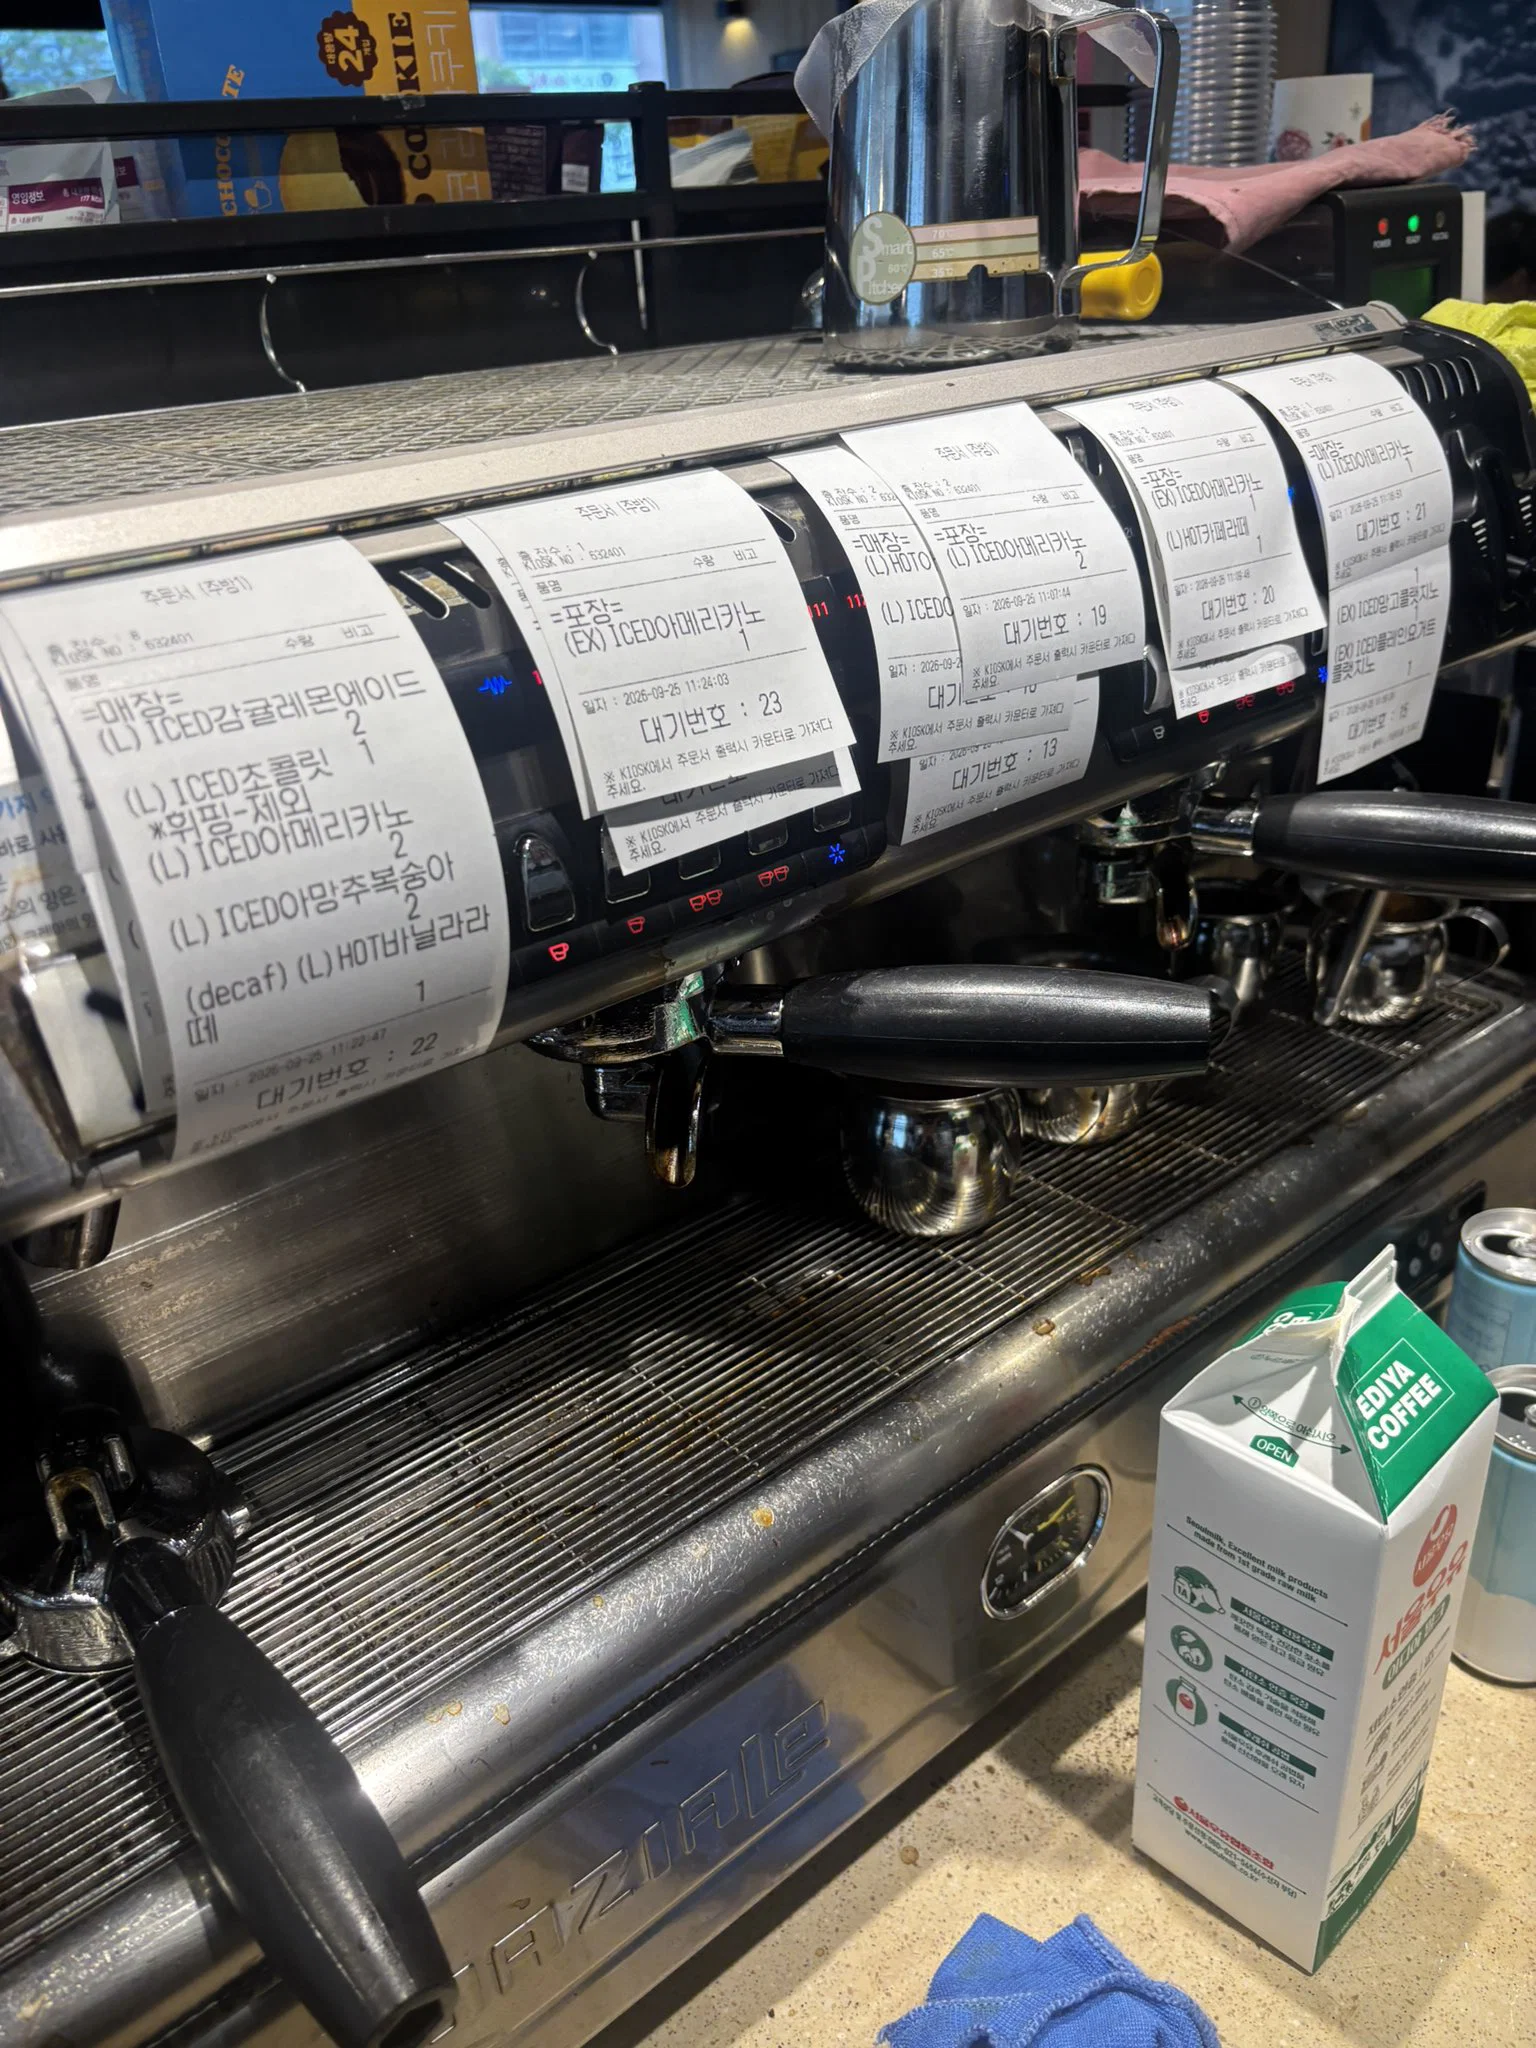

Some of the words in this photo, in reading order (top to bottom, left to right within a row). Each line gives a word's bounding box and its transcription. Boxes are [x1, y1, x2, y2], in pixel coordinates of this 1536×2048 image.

[334, 25, 366, 73] 24
[862, 217, 913, 257] Smart
[1308, 440, 1344, 461] =매장=
[1404, 457, 1413, 473] 1
[1141, 468, 1183, 489] =포장=
[575, 503, 619, 521] 주문서
[1249, 495, 1256, 512] 1
[934, 524, 987, 546] =포장=
[1356, 511, 1400, 541] 대기번호
[1415, 502, 1427, 521] 21
[522, 556, 556, 572] KIOSK
[561, 553, 575, 566] NO
[589, 546, 626, 561] 632401
[693, 554, 715, 569] 수량
[733, 548, 758, 561] 비고
[852, 531, 910, 554] =매장=
[947, 530, 1087, 569] (L)ICED아메리카노
[1256, 535, 1263, 553] 1
[1075, 550, 1087, 570] 2
[140, 584, 197, 607] 주문서
[1201, 593, 1249, 621] 대기번호
[1262, 585, 1275, 605] 20
[550, 598, 623, 629] =포장=
[564, 600, 765, 658] (EX)ICED아메리카노
[1003, 612, 1069, 645] 대기번호
[1091, 604, 1107, 627] 19
[341, 624, 375, 639] 비고
[739, 628, 750, 651] 1
[921, 657, 962, 673] 2026-09-2
[82, 690, 183, 724] =매장=
[582, 699, 608, 715] 일자
[624, 683, 681, 706] 2026-09-25
[685, 673, 729, 694] 11:24:03
[98, 670, 427, 756] (L)ICED감귤레몬에이드
[346, 709, 367, 736] 2
[640, 703, 731, 744] 대기번호
[758, 690, 783, 717] 23
[619, 755, 673, 781] KIOSK에서
[677, 748, 711, 767] 주문서
[751, 729, 796, 749] 카운터로
[952, 752, 1018, 791] 대기번호
[1043, 738, 1058, 759] 13
[124, 746, 334, 818] (L)ICED초콜릿
[359, 740, 376, 766] 1
[695, 806, 728, 826] 주문서
[149, 800, 414, 885] (L)ICED아메리카노
[389, 831, 408, 859] 2
[169, 850, 455, 952] (L)ICED아망추복숭아
[404, 893, 421, 921] 2
[415, 980, 426, 1002] 1
[185, 1013, 219, 1048] 떼
[256, 1057, 369, 1110] 대기번호
[410, 1032, 438, 1056] 22
[1355, 1360, 1415, 1421] EDIYA
[1367, 1372, 1443, 1450] COFFEE
[1256, 1438, 1293, 1464] OPEN
[1193, 1530, 1215, 1549] made
[1216, 1543, 1235, 1561] from
[1238, 1556, 1250, 1568] 1st
[1251, 1564, 1277, 1583] grade
[1277, 1579, 1295, 1593] raw
[1296, 1588, 1317, 1603] milk
[1228, 1541, 1266, 1567] Excellent
[1267, 1564, 1286, 1579] milk
[1288, 1574, 1329, 1600] products
[1373, 1540, 1469, 1676] 서울우유
